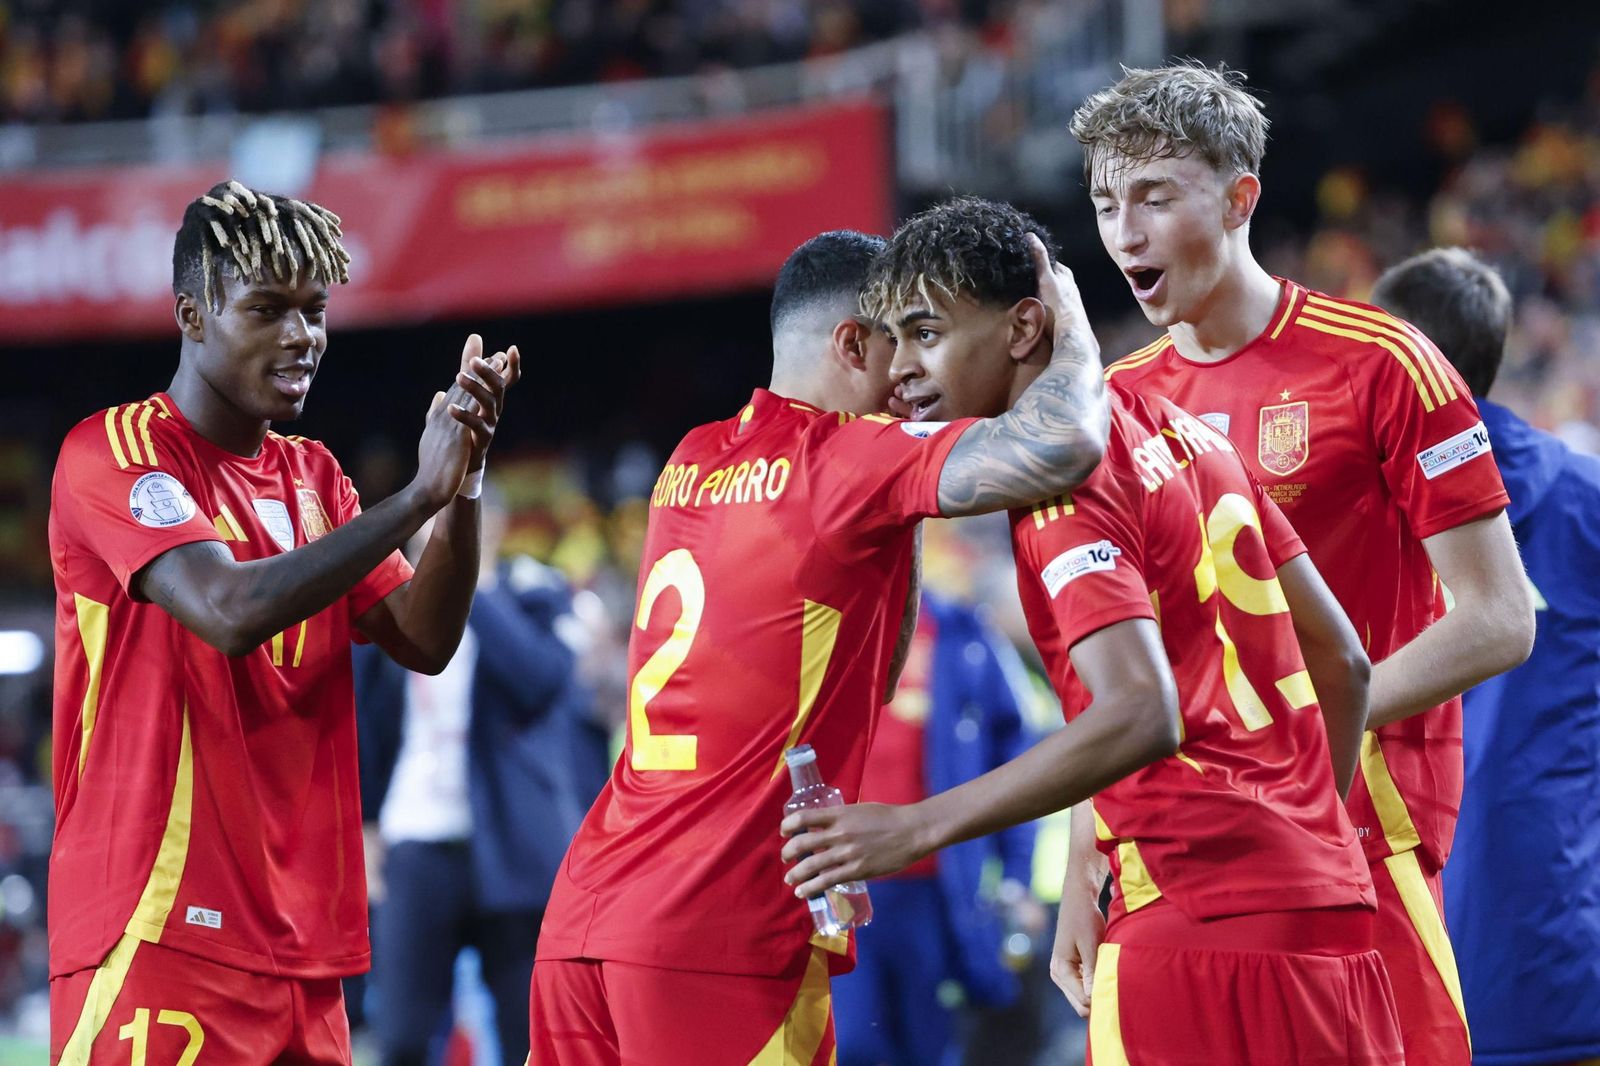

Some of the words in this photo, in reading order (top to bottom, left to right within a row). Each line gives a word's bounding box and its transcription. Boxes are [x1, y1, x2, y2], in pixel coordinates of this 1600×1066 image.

[695, 457, 791, 507] PORRO
[1423, 440, 1475, 469] FOUNDATION
[1194, 493, 1319, 733] 19
[631, 548, 706, 771] 2
[118, 1007, 206, 1066] 17
